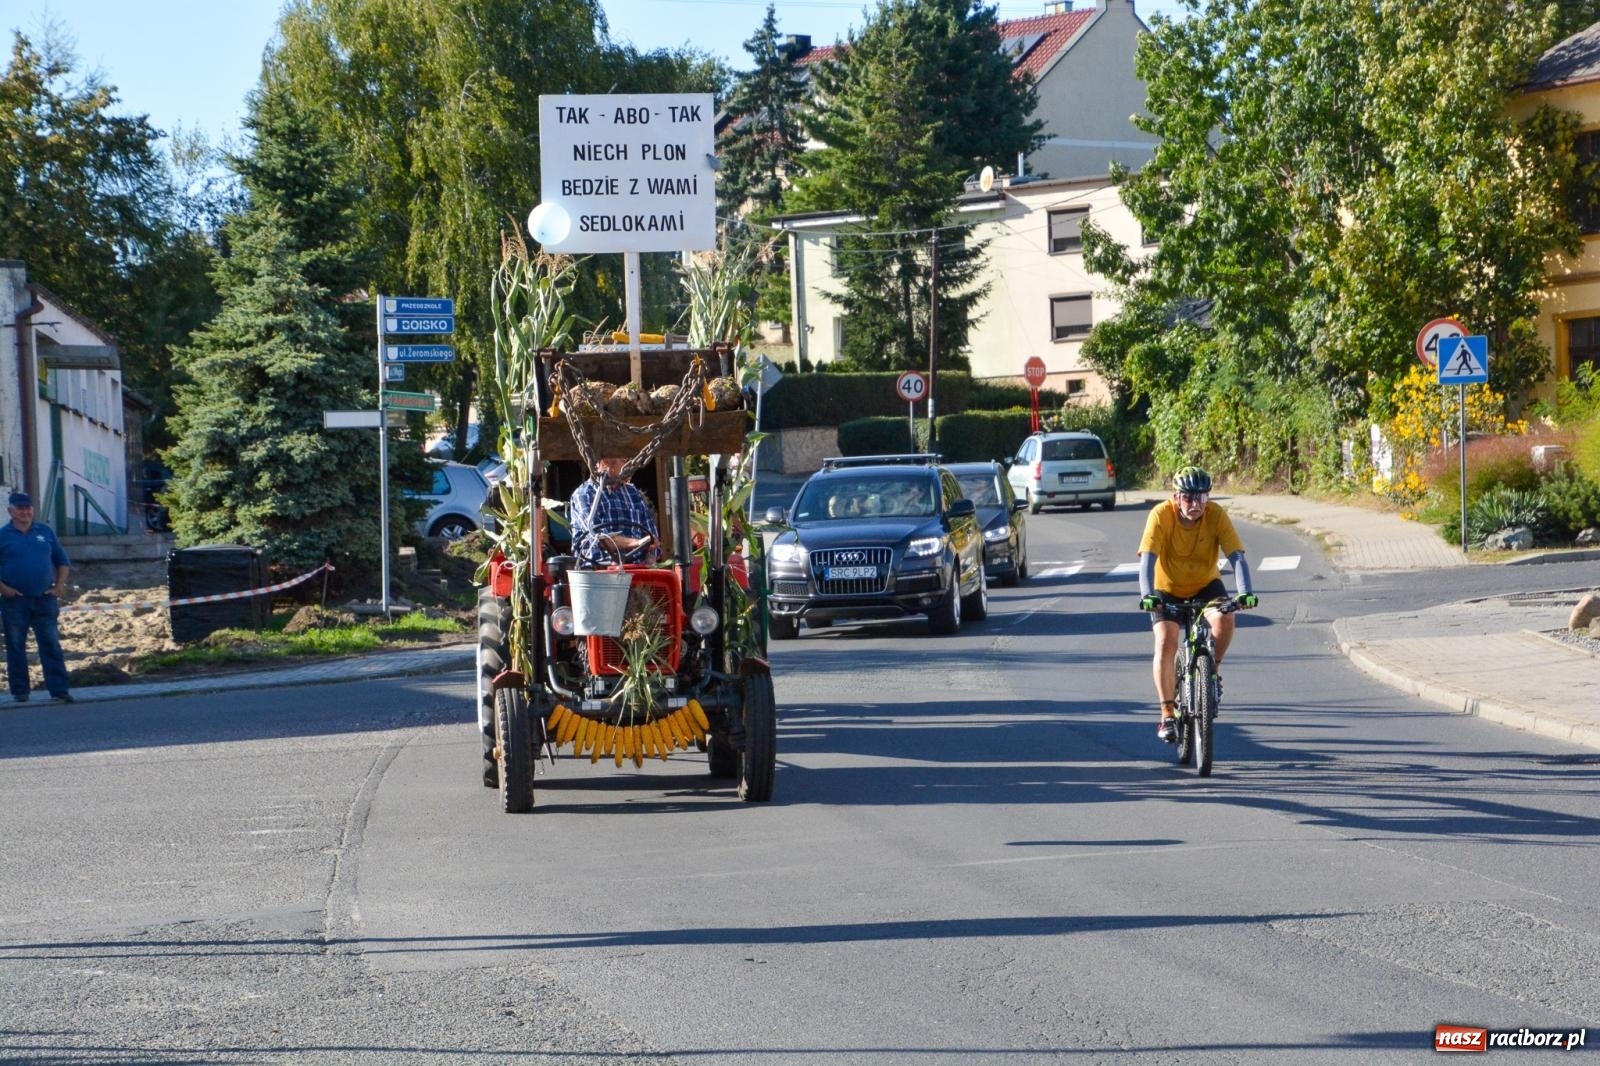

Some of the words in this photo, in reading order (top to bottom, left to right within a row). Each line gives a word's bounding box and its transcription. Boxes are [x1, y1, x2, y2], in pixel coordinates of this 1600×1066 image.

[555, 106, 590, 124] TAK
[613, 106, 650, 124] ABO
[668, 105, 702, 123] TAK
[641, 143, 686, 161] PLON
[629, 178, 639, 195] Z
[401, 320, 448, 330] BOISKO
[1026, 368, 1045, 377] STOP
[902, 379, 923, 394] 40
[831, 568, 850, 578] SRC
